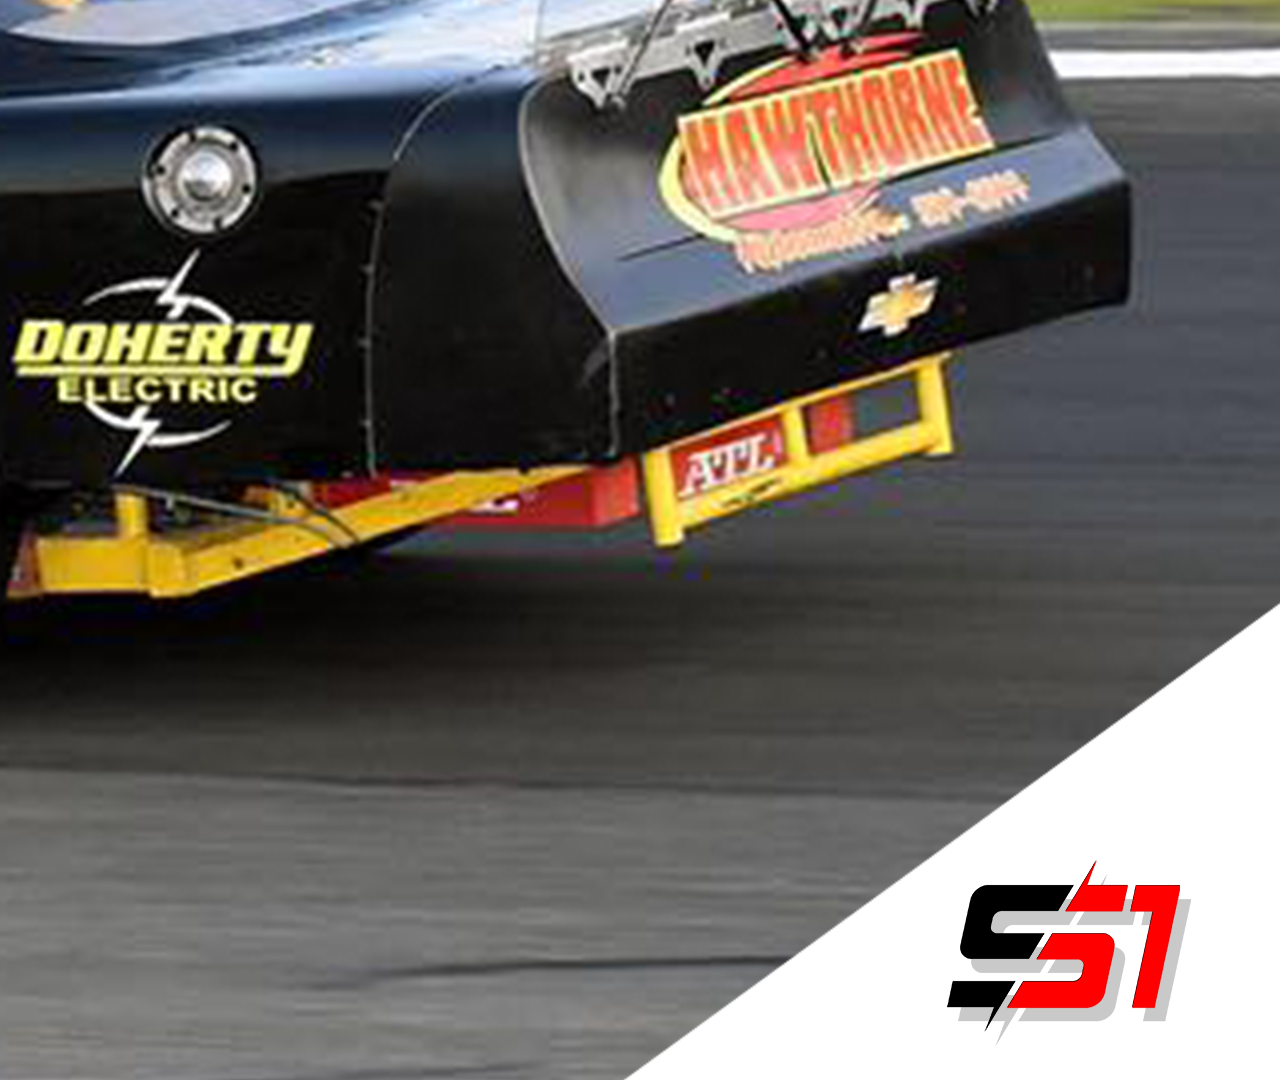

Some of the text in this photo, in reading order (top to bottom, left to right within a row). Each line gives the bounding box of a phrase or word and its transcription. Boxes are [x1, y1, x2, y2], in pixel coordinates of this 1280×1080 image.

[678, 48, 996, 220] HAWTHORNE
[12, 319, 314, 377] DOHERTY
[57, 377, 259, 402] ELECTRIC
[677, 433, 776, 498] ATL
